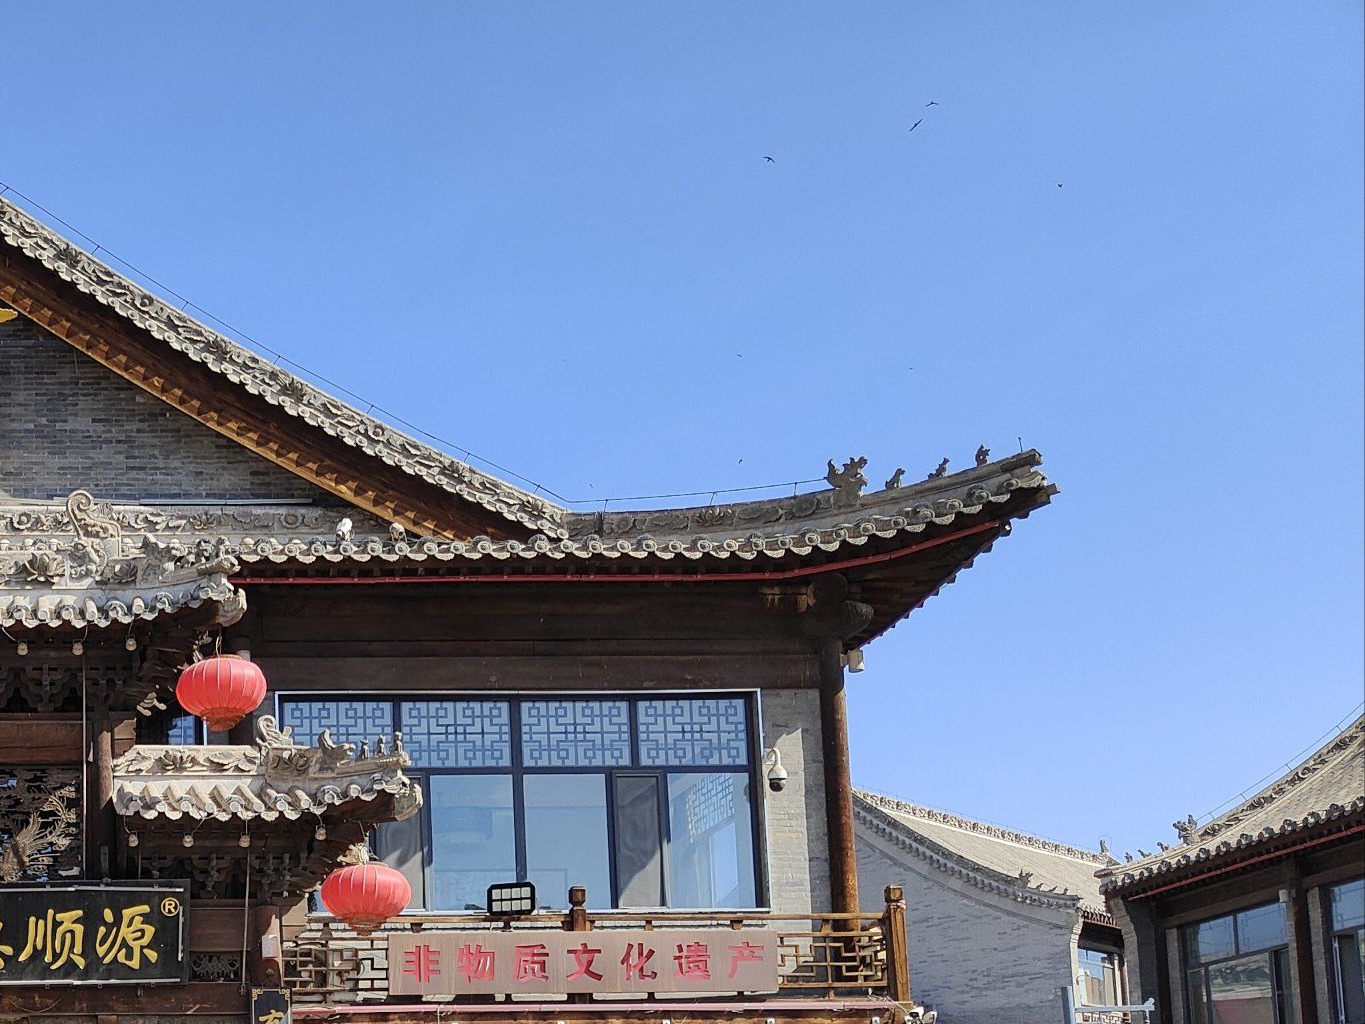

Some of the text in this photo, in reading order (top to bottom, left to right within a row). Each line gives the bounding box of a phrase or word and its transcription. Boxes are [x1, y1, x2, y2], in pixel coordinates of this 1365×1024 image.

[402, 941, 765, 983] 非物质文化遗产
